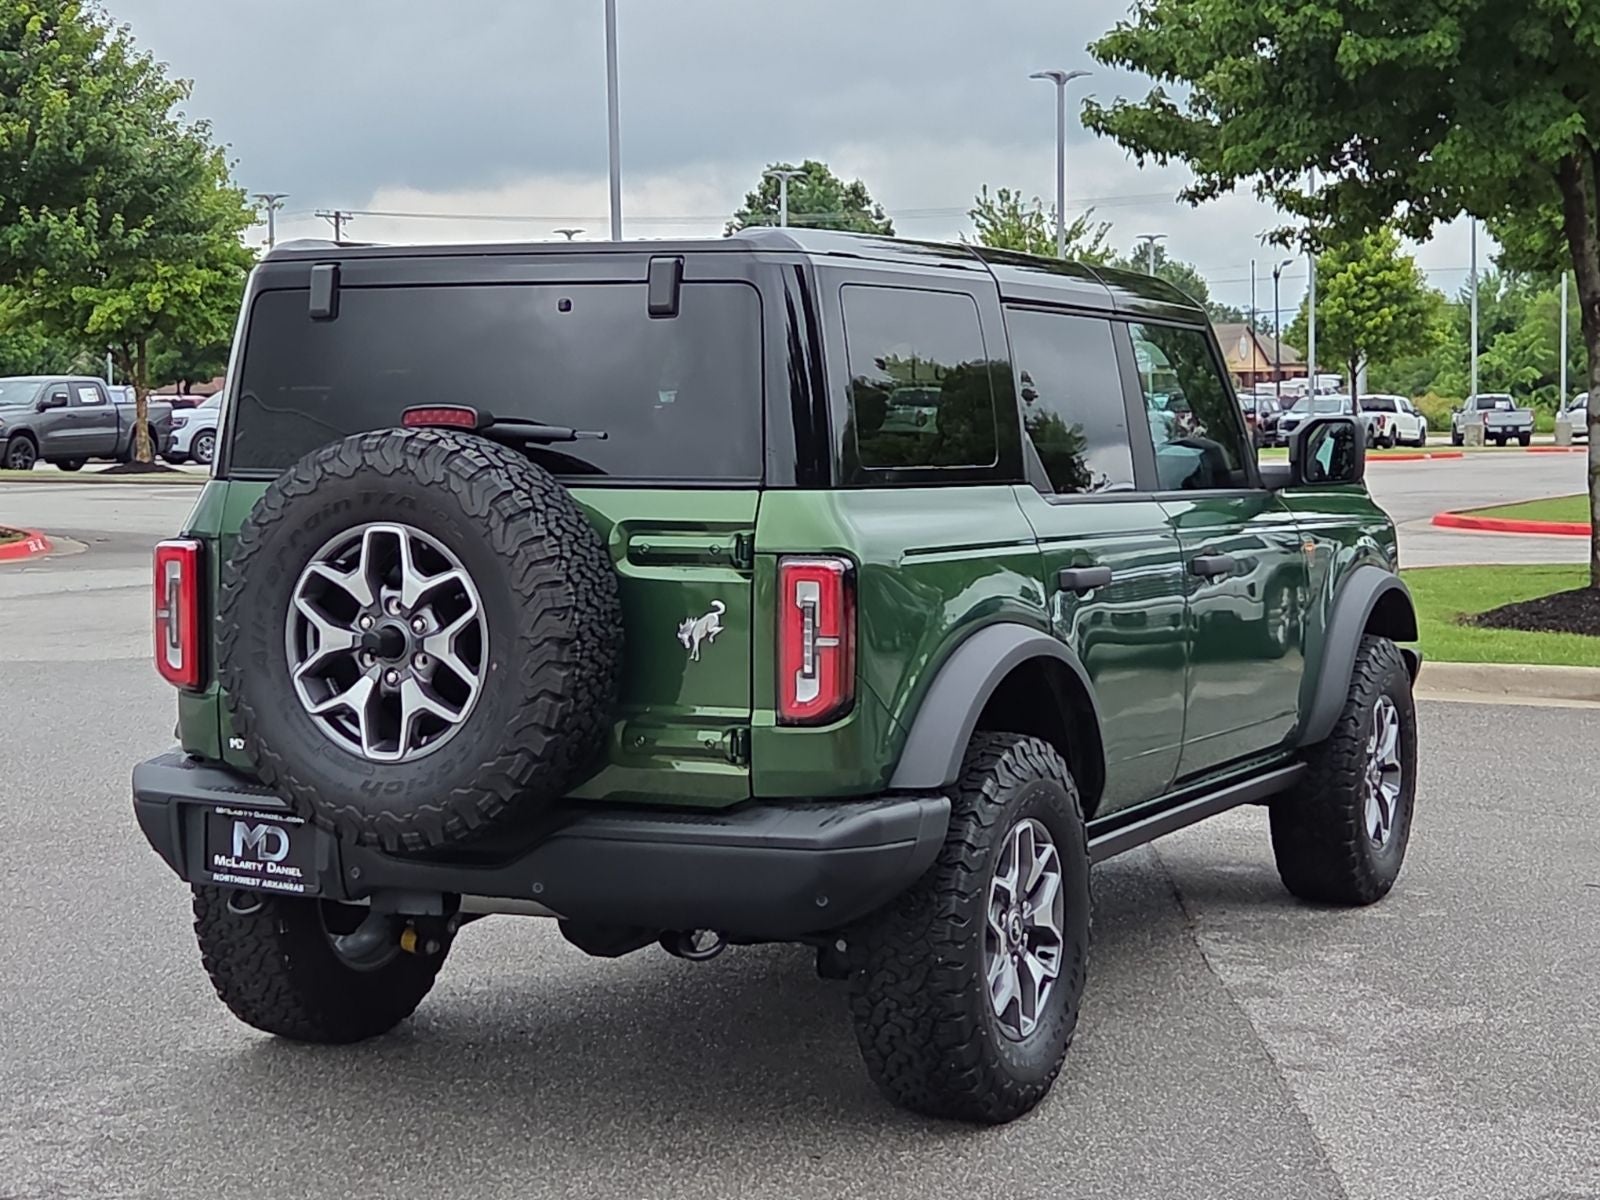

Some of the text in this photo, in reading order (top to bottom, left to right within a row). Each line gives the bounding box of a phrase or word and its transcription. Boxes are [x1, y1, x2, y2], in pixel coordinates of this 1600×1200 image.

[233, 821, 290, 862] MD
[267, 862, 302, 877] DANIEL
[213, 873, 304, 892] NORTHWEST ARKANSAS
